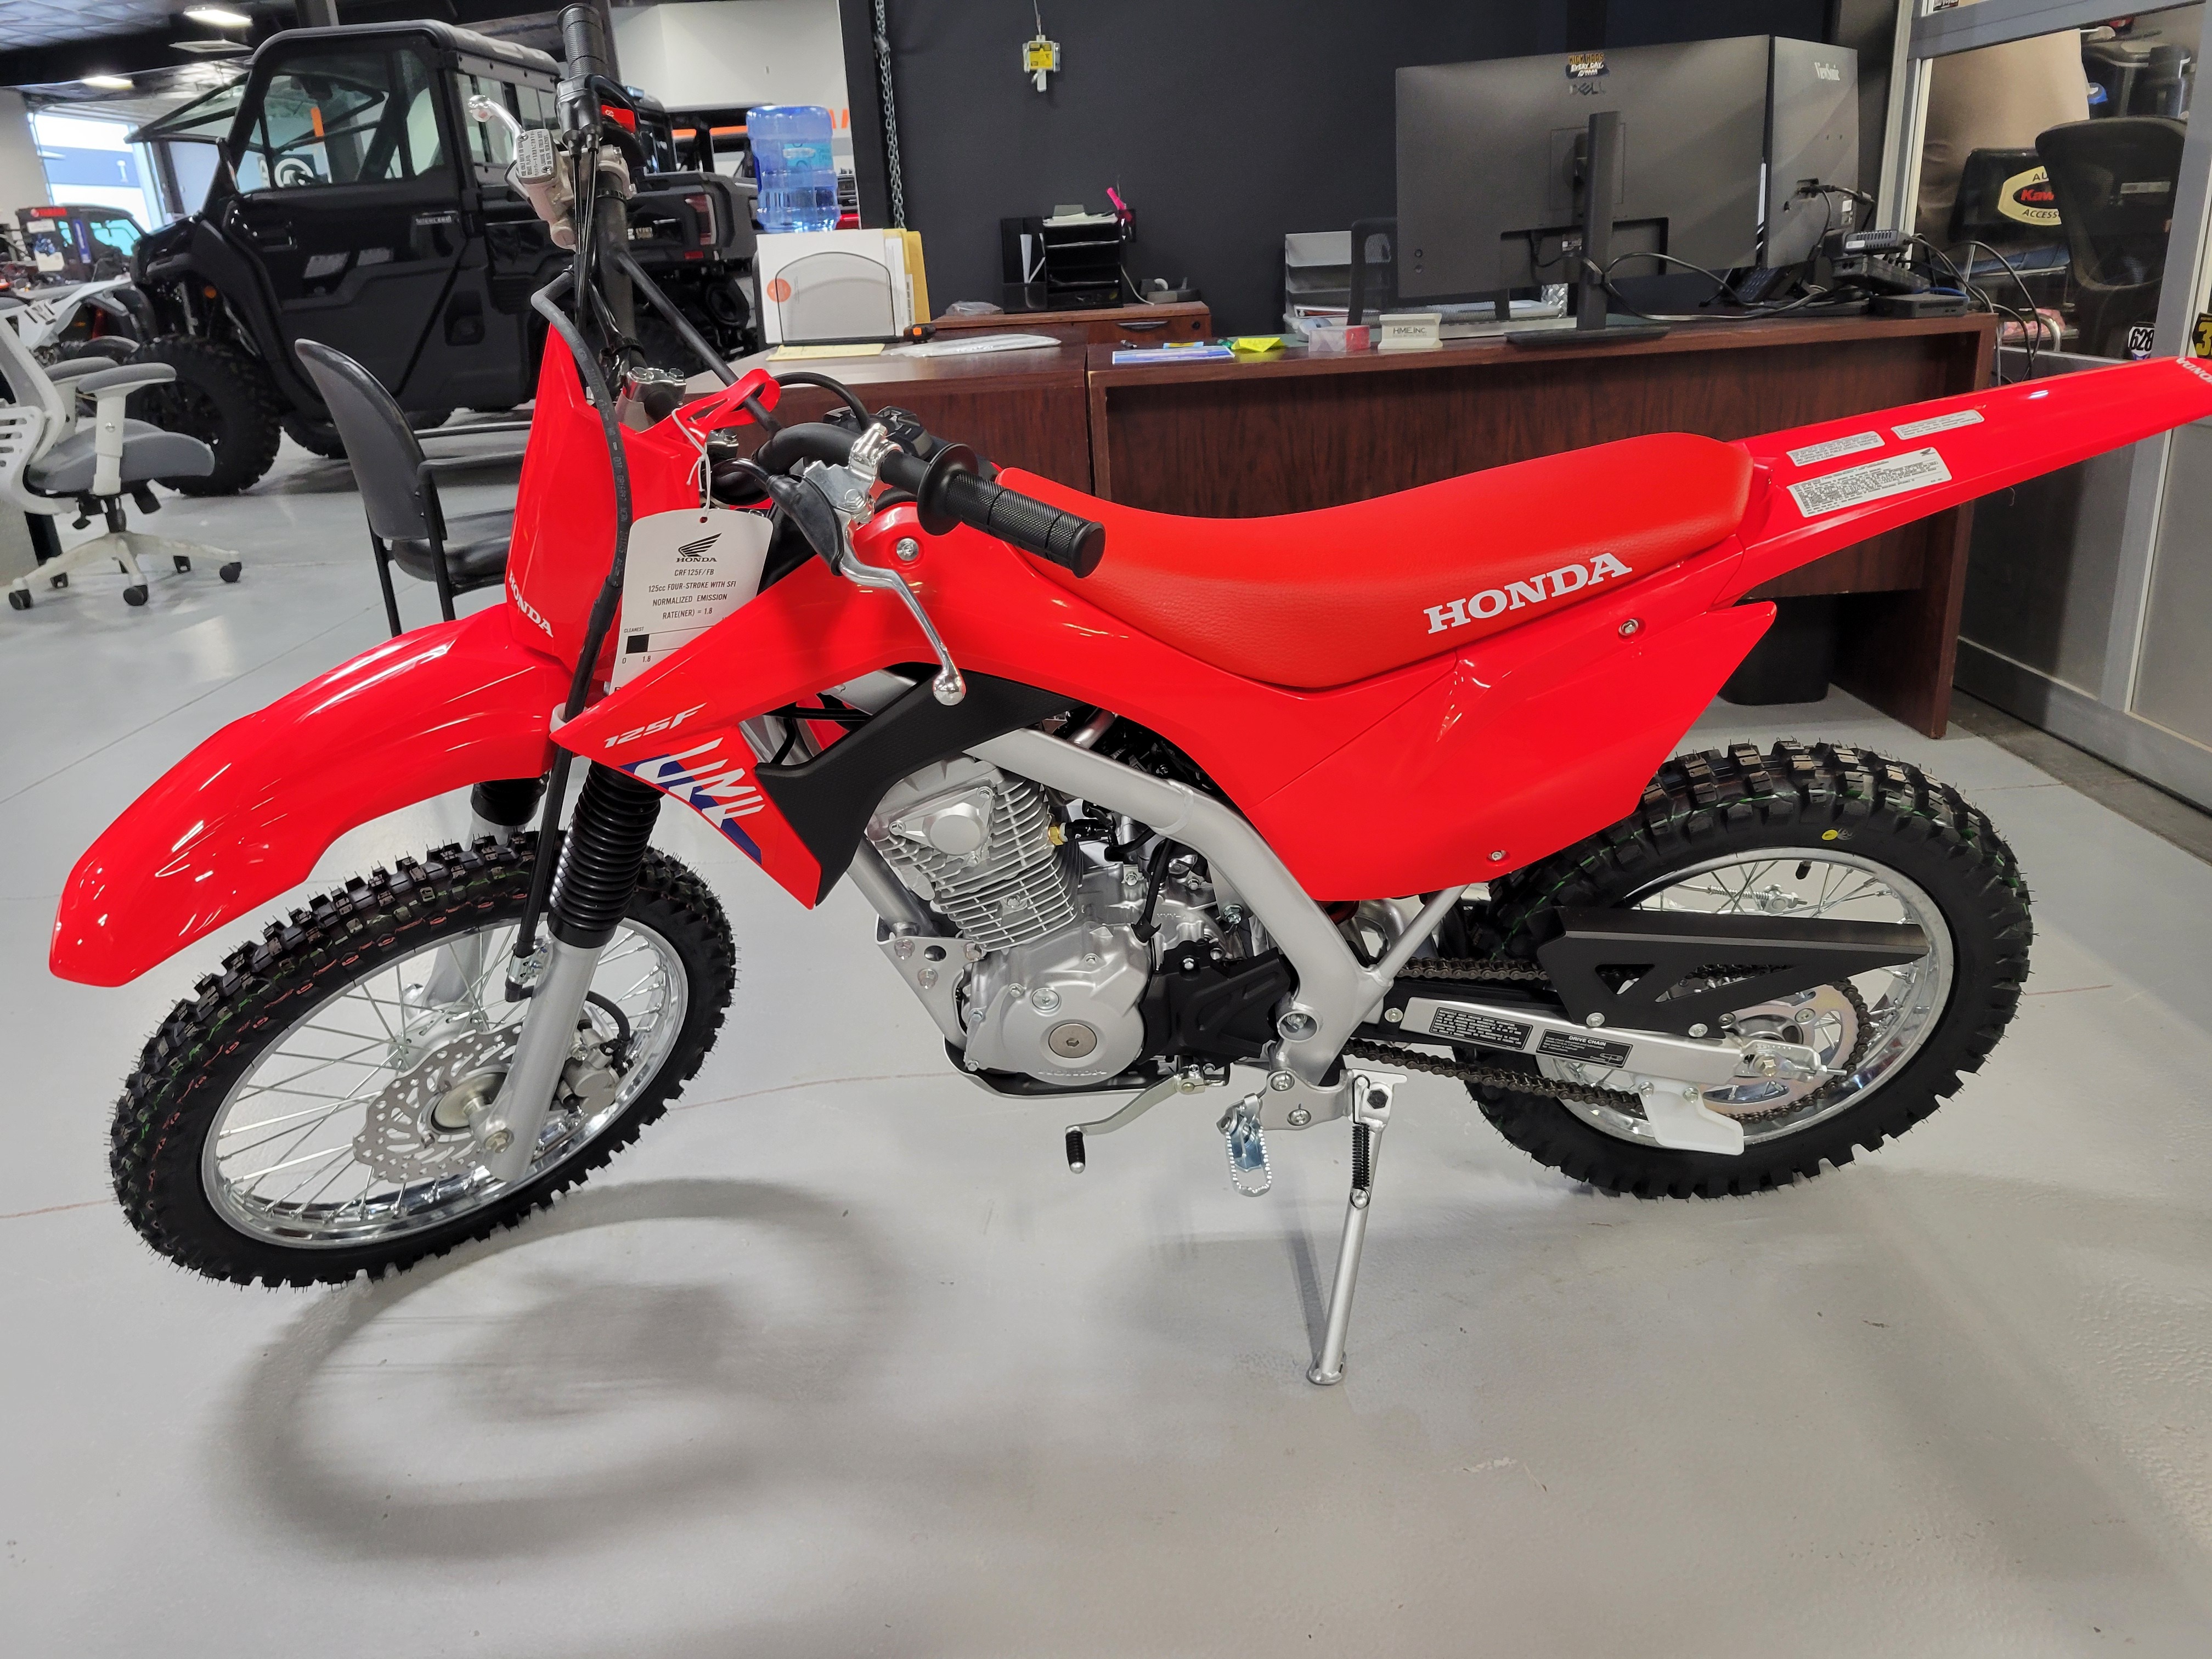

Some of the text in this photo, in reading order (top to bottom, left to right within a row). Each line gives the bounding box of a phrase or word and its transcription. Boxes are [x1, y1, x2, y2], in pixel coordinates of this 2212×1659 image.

[1569, 82, 1607, 95] DELL
[2129, 328, 2155, 352] 628
[648, 585, 666, 593] 125cc
[667, 582, 709, 591] FOUR-STROKE
[1423, 552, 1633, 635] HONDA
[509, 568, 554, 638] HONDA
[652, 593, 728, 607] NORMALIZED EMISSION
[662, 609, 696, 620] RATE(NER)
[604, 702, 708, 749] 125F
